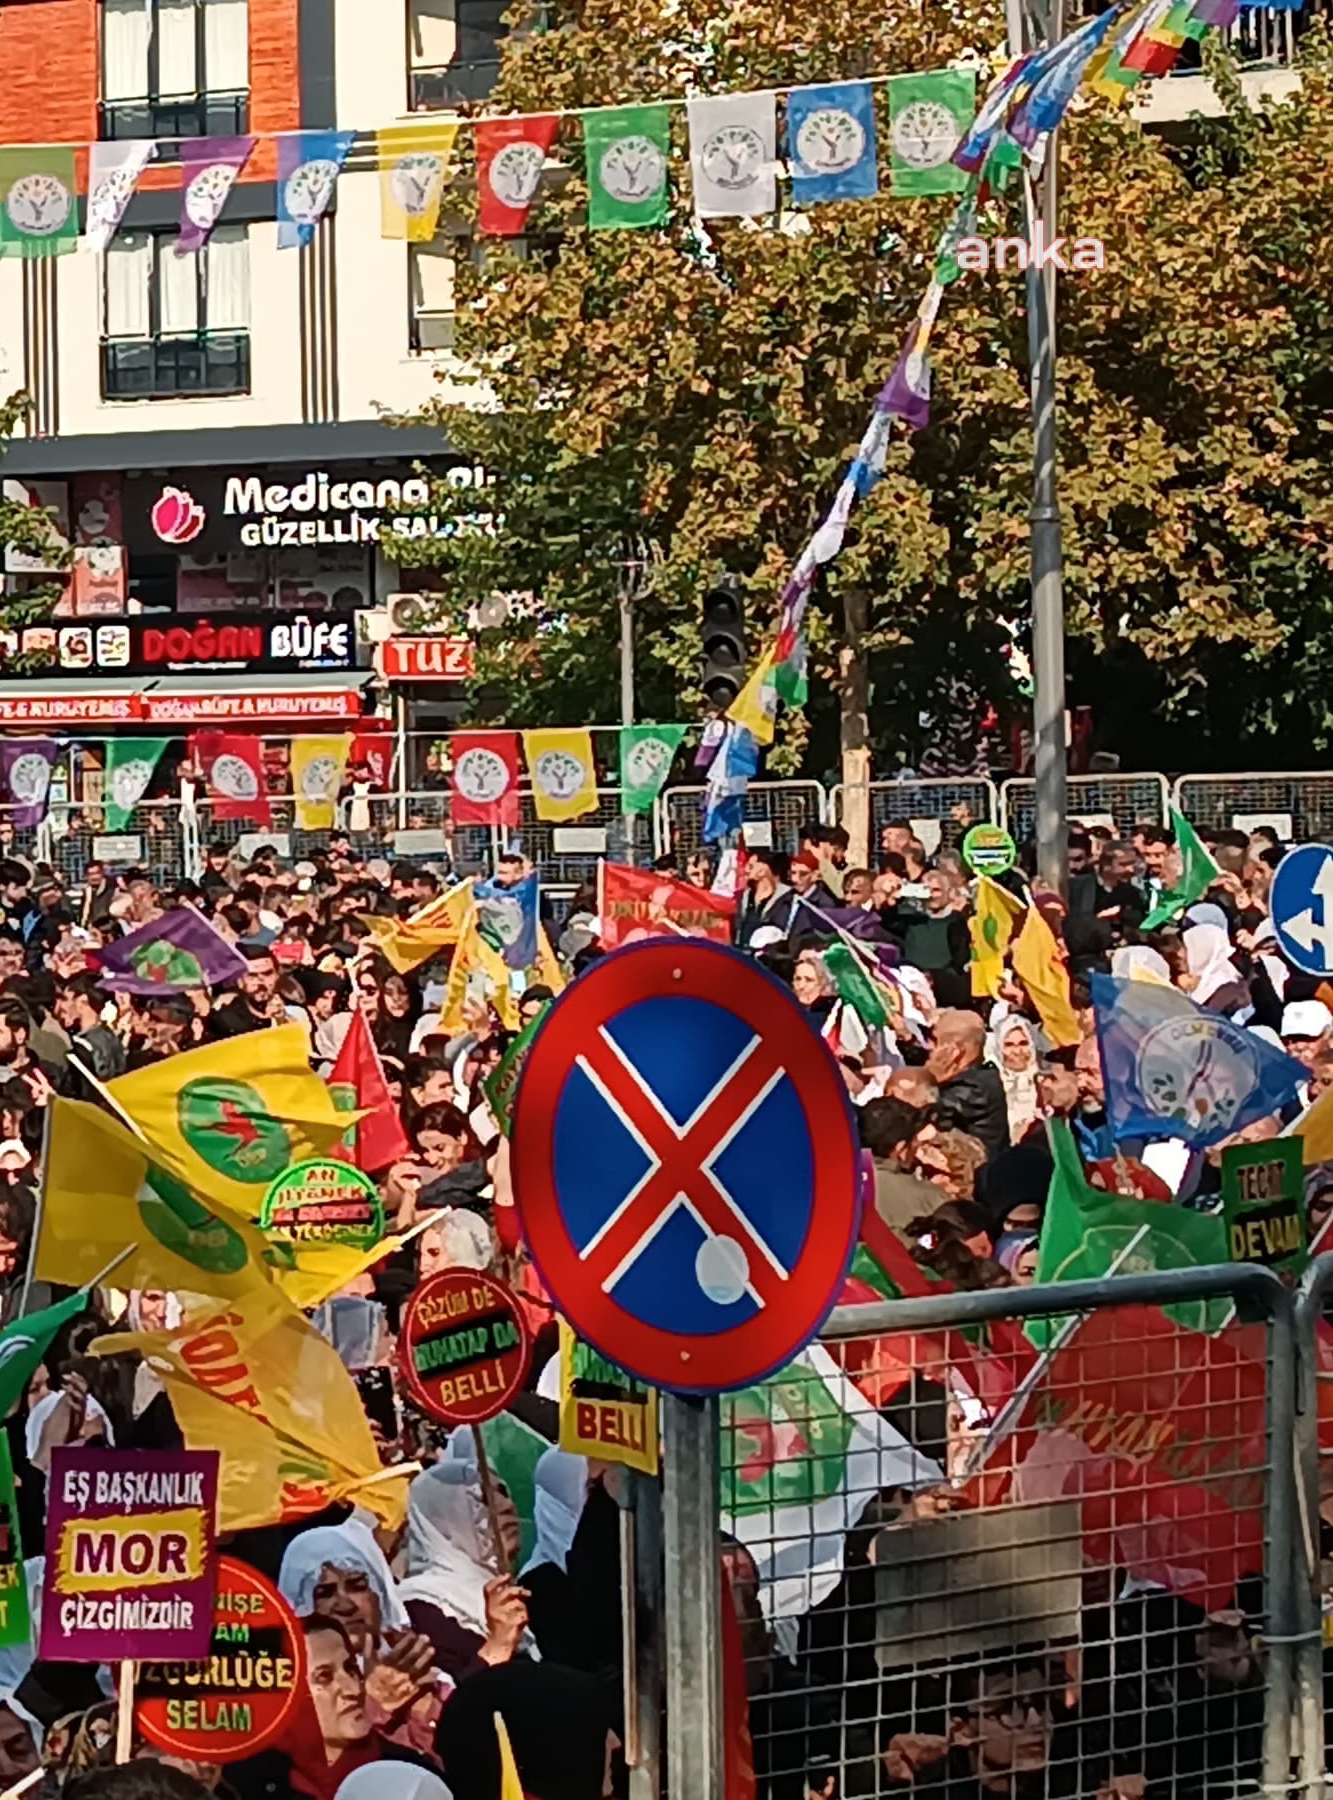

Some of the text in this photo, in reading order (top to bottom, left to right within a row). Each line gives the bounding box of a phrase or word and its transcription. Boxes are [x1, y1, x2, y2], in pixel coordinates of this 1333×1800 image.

[223, 471, 430, 515] Medicana
[241, 510, 381, 547] GÜZELLİK
[143, 616, 349, 661] DOĞAN BÜFE
[63, 1470, 205, 1513] EŞ BAŞKANLIK
[74, 1532, 189, 1574] MOR
[166, 1699, 253, 1732] SELAM
